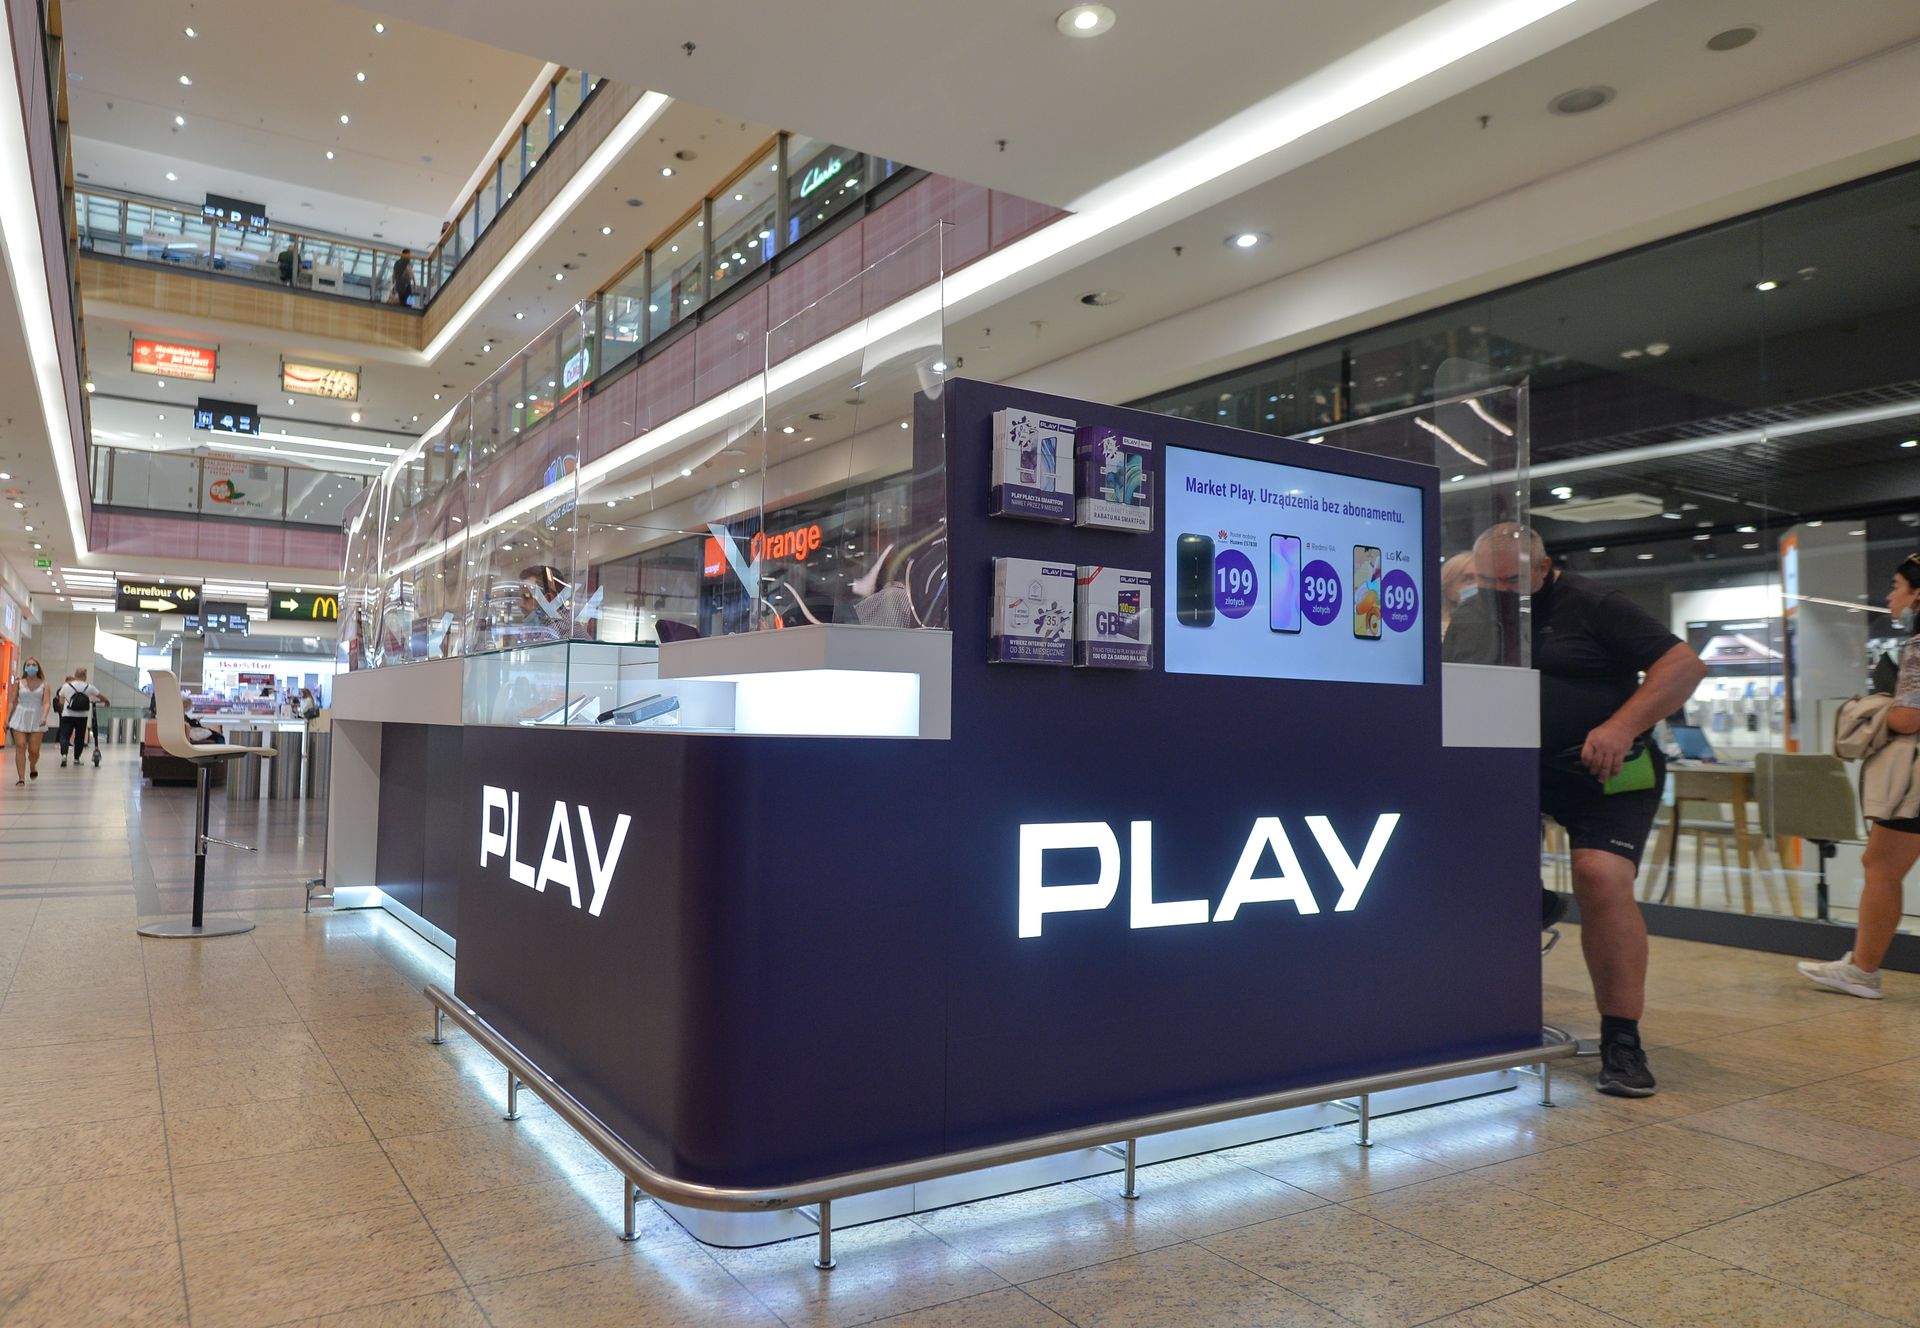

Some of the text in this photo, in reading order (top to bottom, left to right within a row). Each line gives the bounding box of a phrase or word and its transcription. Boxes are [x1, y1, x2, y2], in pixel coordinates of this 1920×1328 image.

[1040, 422, 1057, 430] PLAY
[1011, 491, 1022, 499] PLAY
[1041, 497, 1064, 506] SMARTFON
[1186, 476, 1405, 524] Market Play. Urządzenia bez abonamentu.
[1094, 511, 1113, 521] RABATU
[1121, 515, 1146, 525] SMARTFON
[751, 525, 821, 561] Orange
[1386, 553, 1395, 561] LG
[1042, 568, 1060, 576] PLAY
[1121, 576, 1136, 584] PLAY
[1217, 567, 1253, 595] 199
[123, 585, 172, 597] Carrefour
[1305, 576, 1338, 603] 399
[1385, 585, 1415, 611] 699
[1046, 616, 1057, 626] 35
[1096, 611, 1120, 635] GB
[1018, 646, 1025, 654] 35
[1028, 640, 1047, 648] INTERNET
[480, 785, 632, 918] PLAY
[1019, 803, 1400, 939] PLAY
